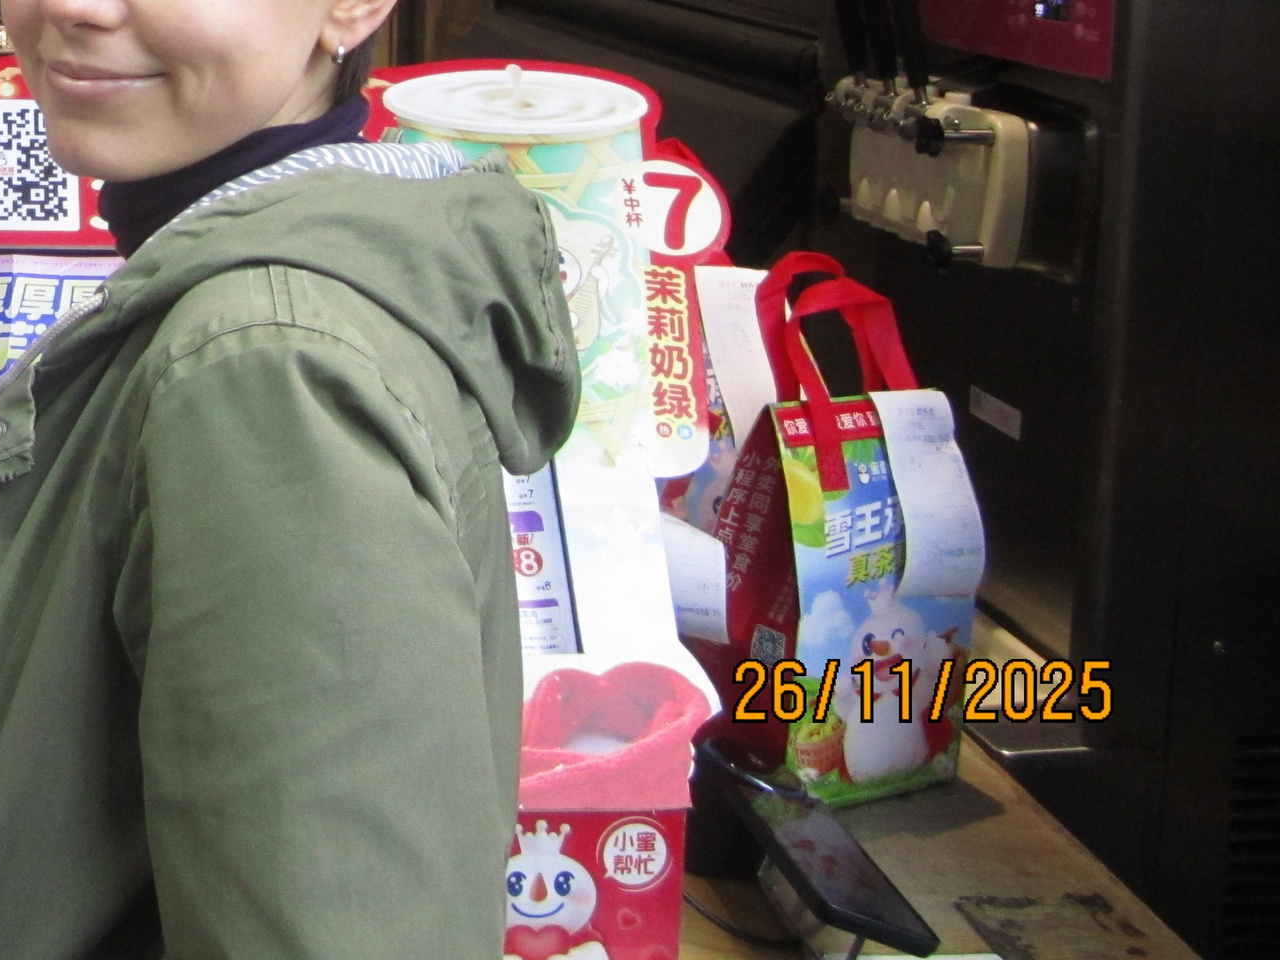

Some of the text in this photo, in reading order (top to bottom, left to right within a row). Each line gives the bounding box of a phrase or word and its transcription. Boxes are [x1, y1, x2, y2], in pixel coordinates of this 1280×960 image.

[642, 171, 703, 250] 7
[644, 268, 694, 420] 茉莉奶绿
[613, 831, 656, 852] 小蜜
[613, 854, 656, 875] 帮忙
